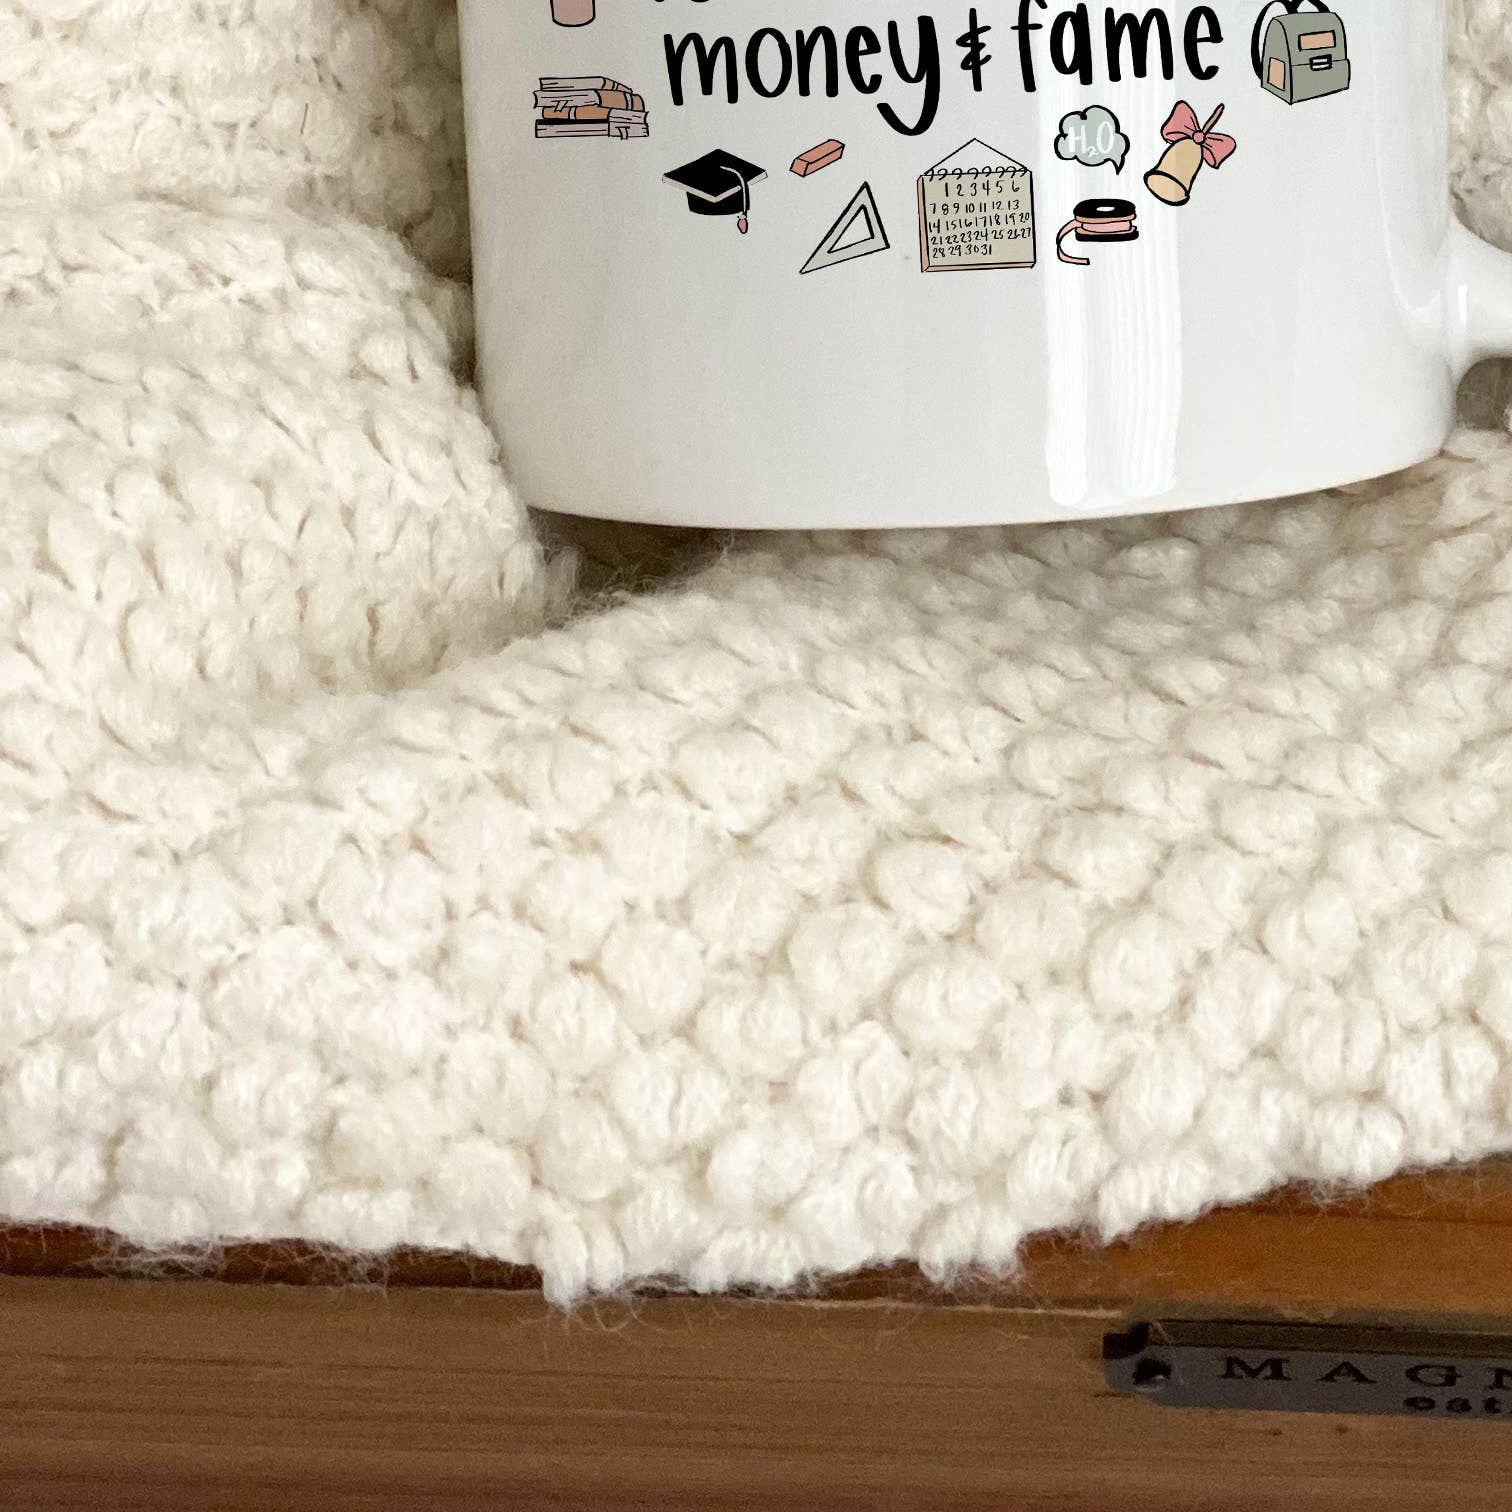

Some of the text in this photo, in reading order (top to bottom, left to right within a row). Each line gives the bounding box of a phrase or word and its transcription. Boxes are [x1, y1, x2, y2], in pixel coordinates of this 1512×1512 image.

[663, 15, 941, 137] money
[955, 7, 992, 92] &
[944, 180, 1020, 197] 1 2 3 4 5 6
[929, 199, 1020, 216] 7 8 9 10 11 12 13
[928, 212, 1030, 234] 14 15 16 17 18 19 20
[930, 236, 943, 245] 21
[945, 234, 959, 244] 22
[960, 230, 972, 242] 23
[973, 228, 989, 242] 24
[991, 229, 1004, 240] 25
[1020, 227, 1031, 239] 27
[932, 244, 992, 259] 28 29 30 31
